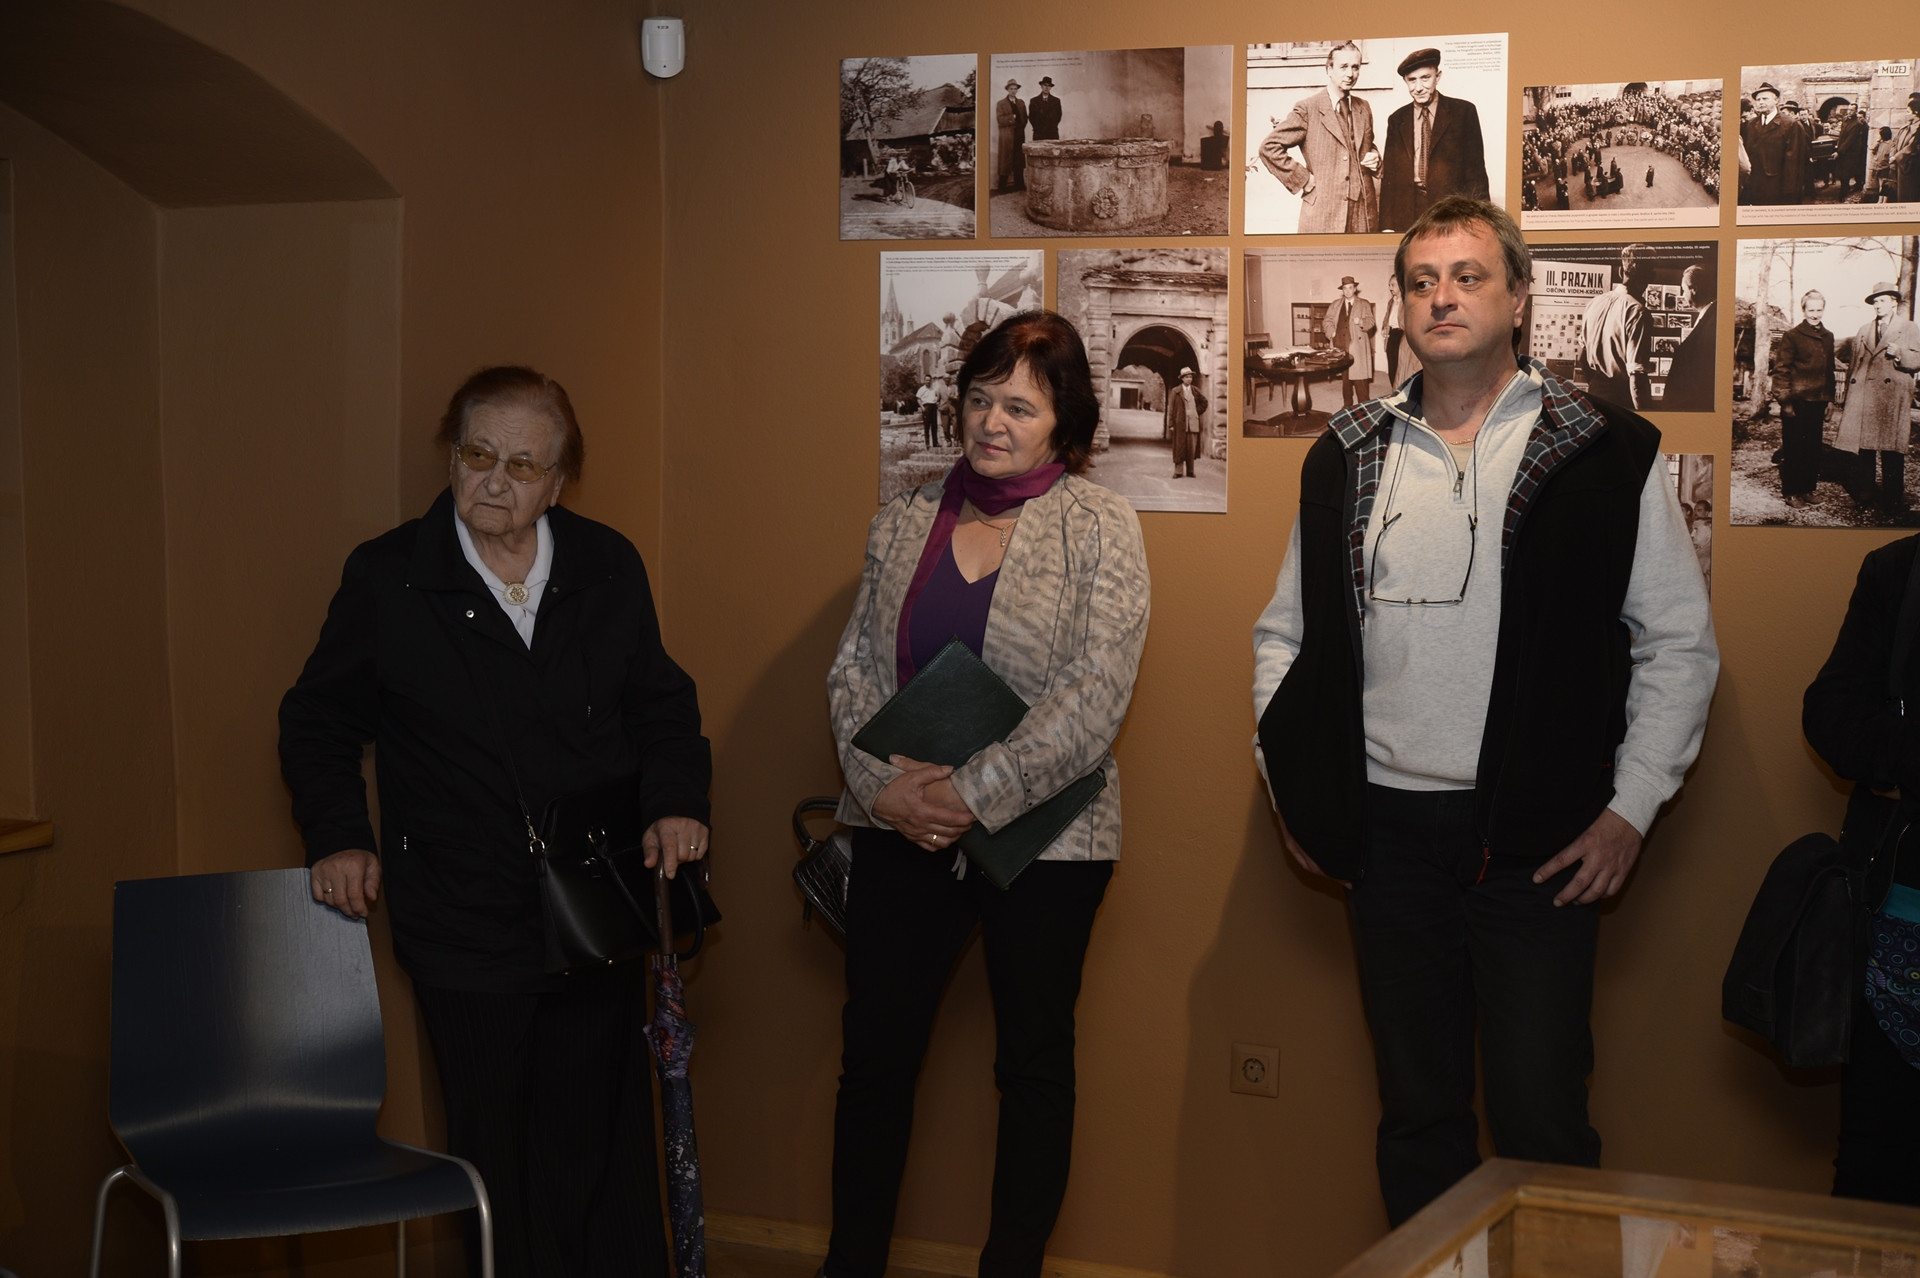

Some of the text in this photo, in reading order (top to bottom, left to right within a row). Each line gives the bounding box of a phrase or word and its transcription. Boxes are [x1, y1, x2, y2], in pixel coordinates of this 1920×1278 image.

[1881, 65, 1907, 74] MUZEJ
[1546, 270, 1604, 288] III. PRAZNIK
[1567, 287, 1604, 295] VIDEM-KRŠKO
